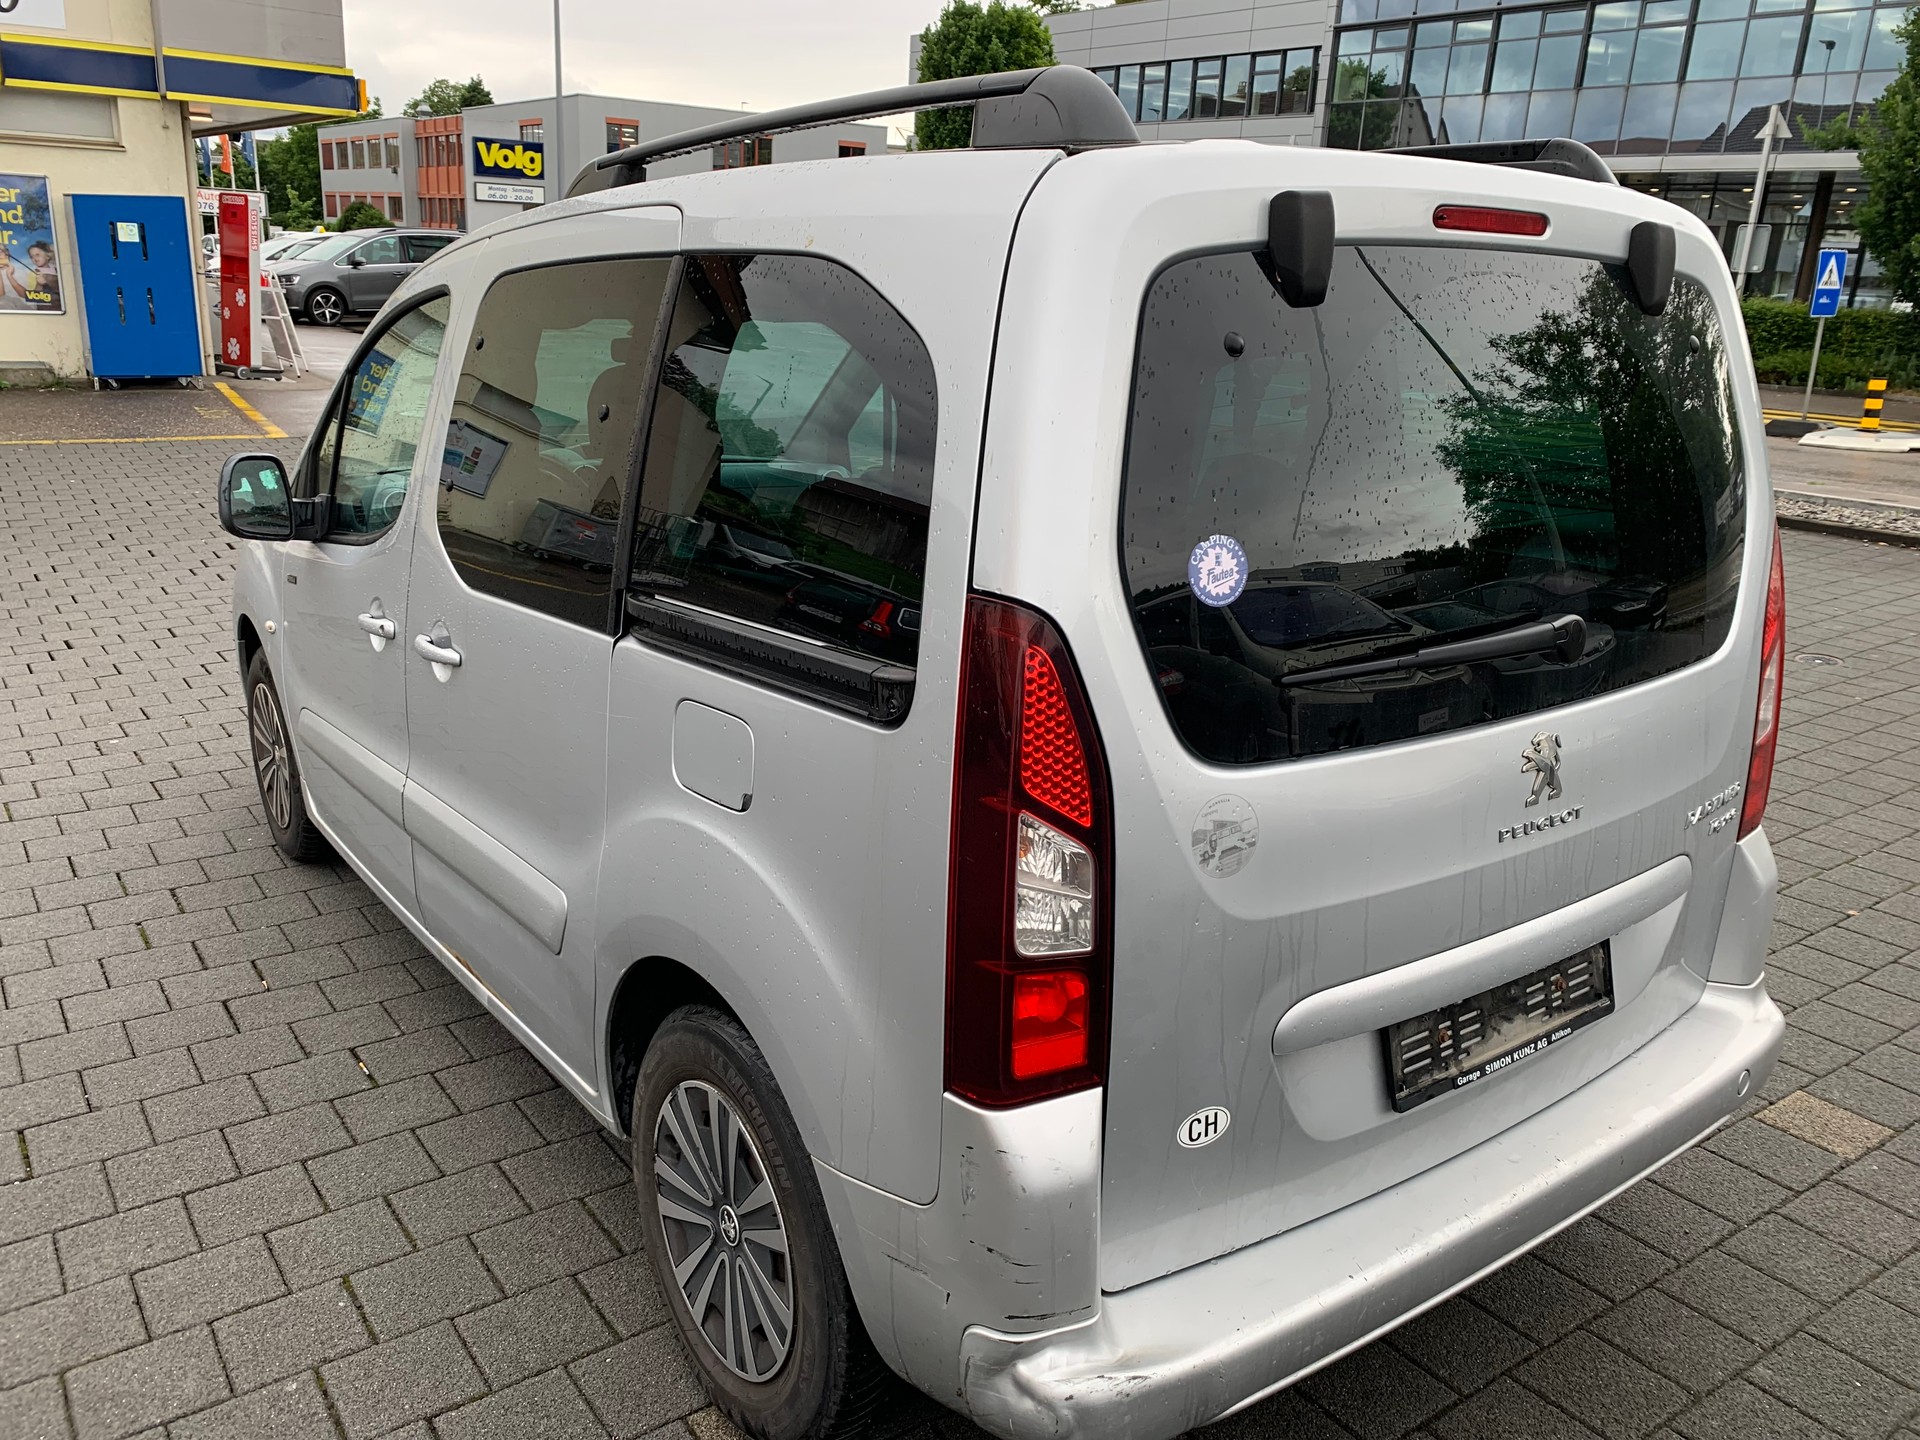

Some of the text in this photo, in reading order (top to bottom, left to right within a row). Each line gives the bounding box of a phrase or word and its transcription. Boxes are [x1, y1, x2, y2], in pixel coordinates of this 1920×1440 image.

[476, 141, 542, 177] Volg
[512, 186, 533, 194] Samstag
[26, 291, 52, 301] Volg
[1191, 534, 1235, 565] CAMPING
[1207, 567, 1234, 586] Fautea
[1684, 781, 1741, 831] PARTNER
[1498, 804, 1584, 843] PEUGEOT
[1457, 1027, 1572, 1086] Garage SIMON KUNZ AG Altikon
[725, 1067, 793, 1190] MICHELIN
[1188, 1111, 1218, 1143] CH
